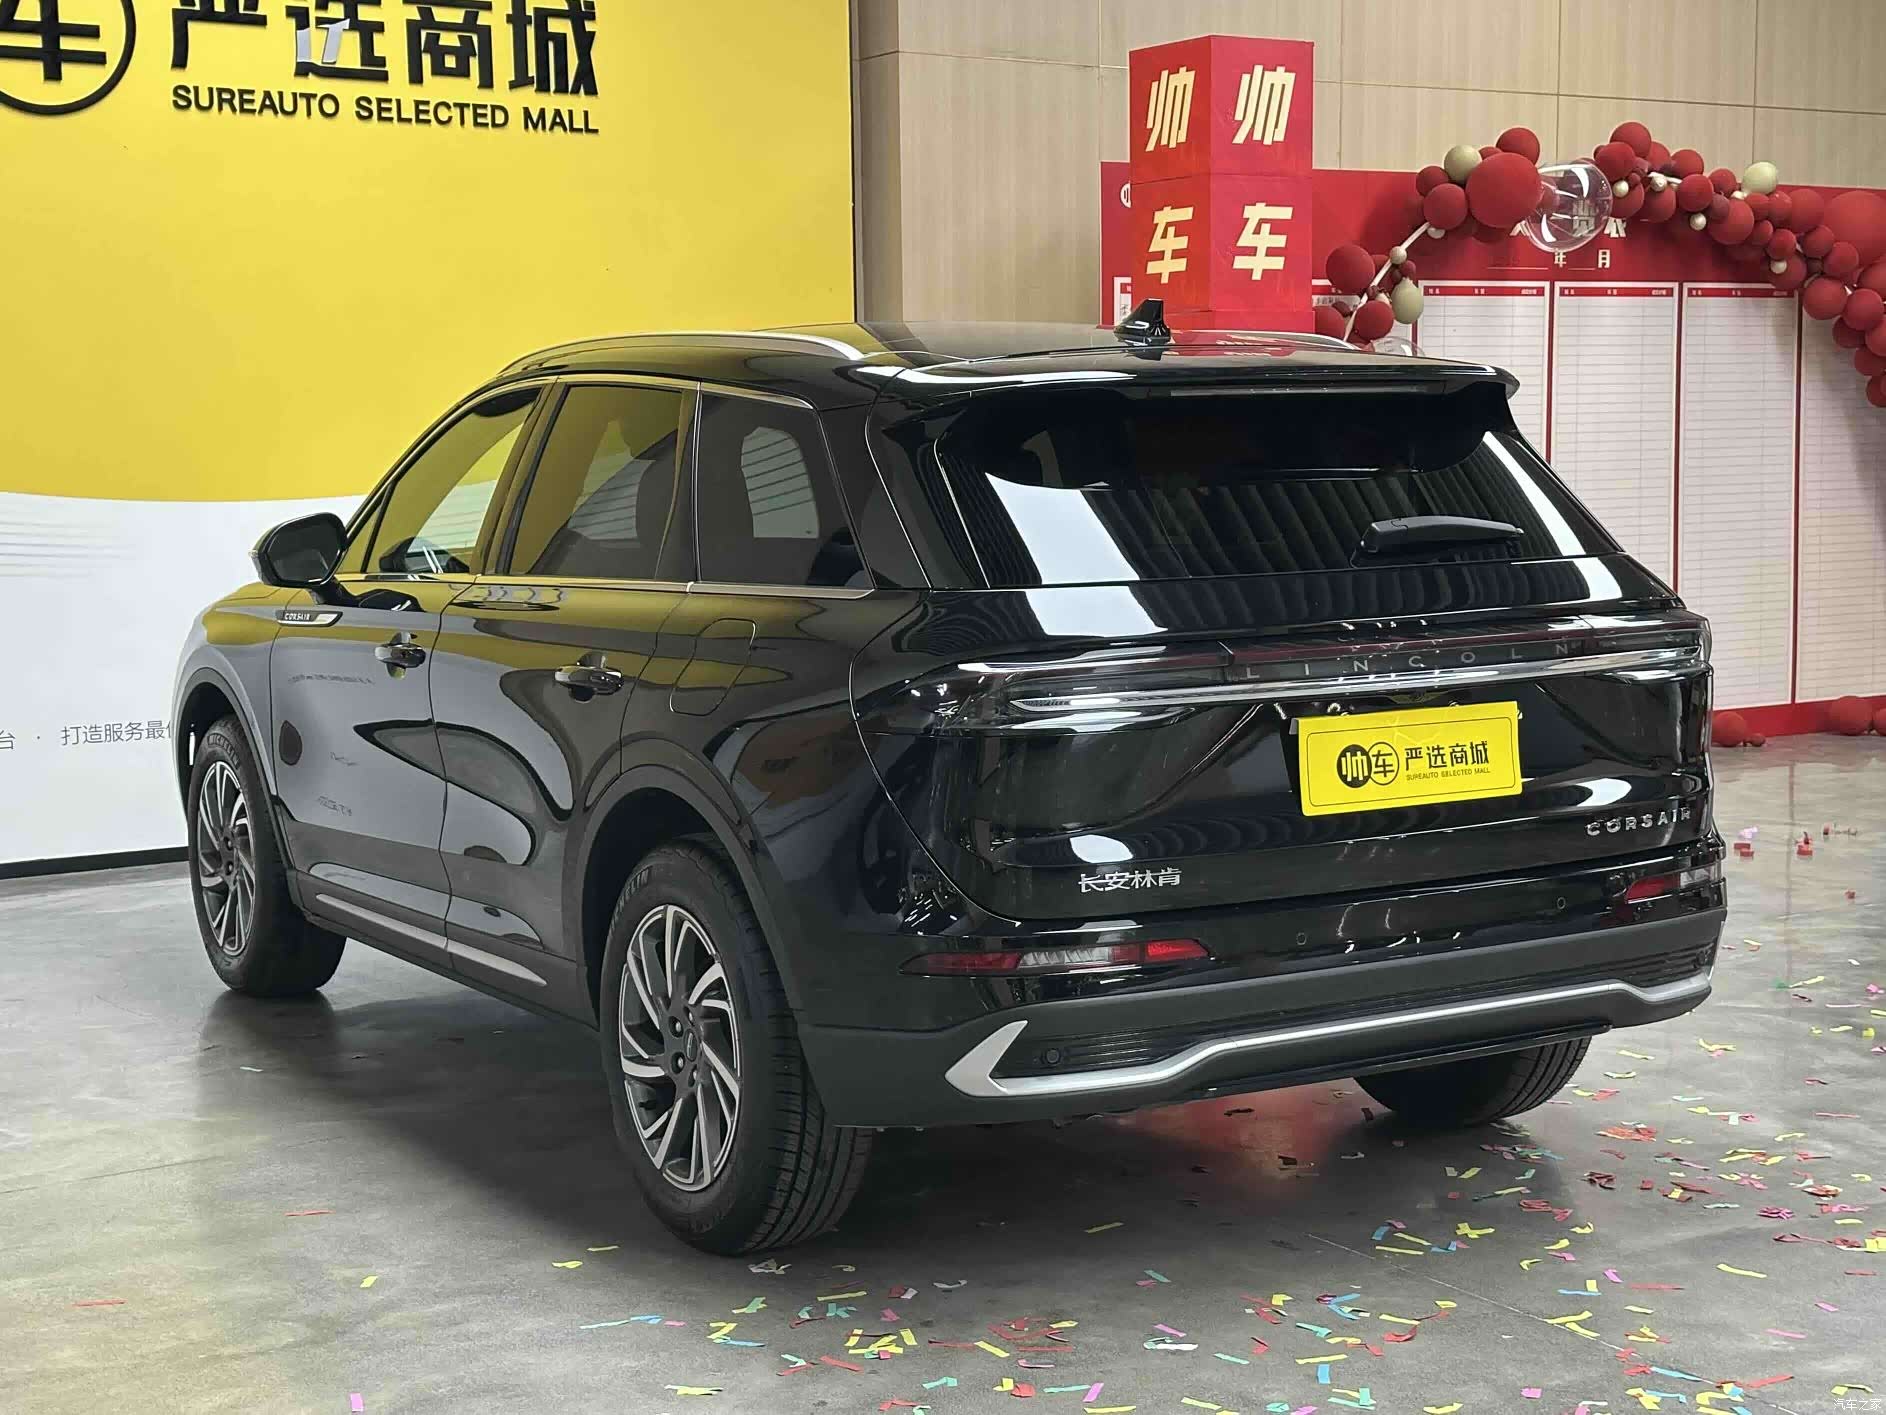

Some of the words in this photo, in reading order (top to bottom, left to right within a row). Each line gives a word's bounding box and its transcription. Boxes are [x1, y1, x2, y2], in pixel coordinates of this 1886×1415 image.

[171, 0, 599, 97] 严选商城
[172, 85, 340, 119] SUREAUTO
[355, 96, 510, 129] SELECTED
[523, 106, 600, 135] MALL
[1145, 66, 1196, 152] 帅
[1232, 64, 1296, 146] 帅
[1146, 206, 1194, 284] 车
[1232, 202, 1294, 281] 车
[1597, 249, 1611, 268] 月
[1246, 643, 1569, 679] LINCOLN
[61, 720, 172, 747] 打造服务最
[1404, 740, 1490, 772] 严选商城
[1585, 806, 1691, 836] CORSAIR
[1078, 866, 1182, 893] 长安林肯
